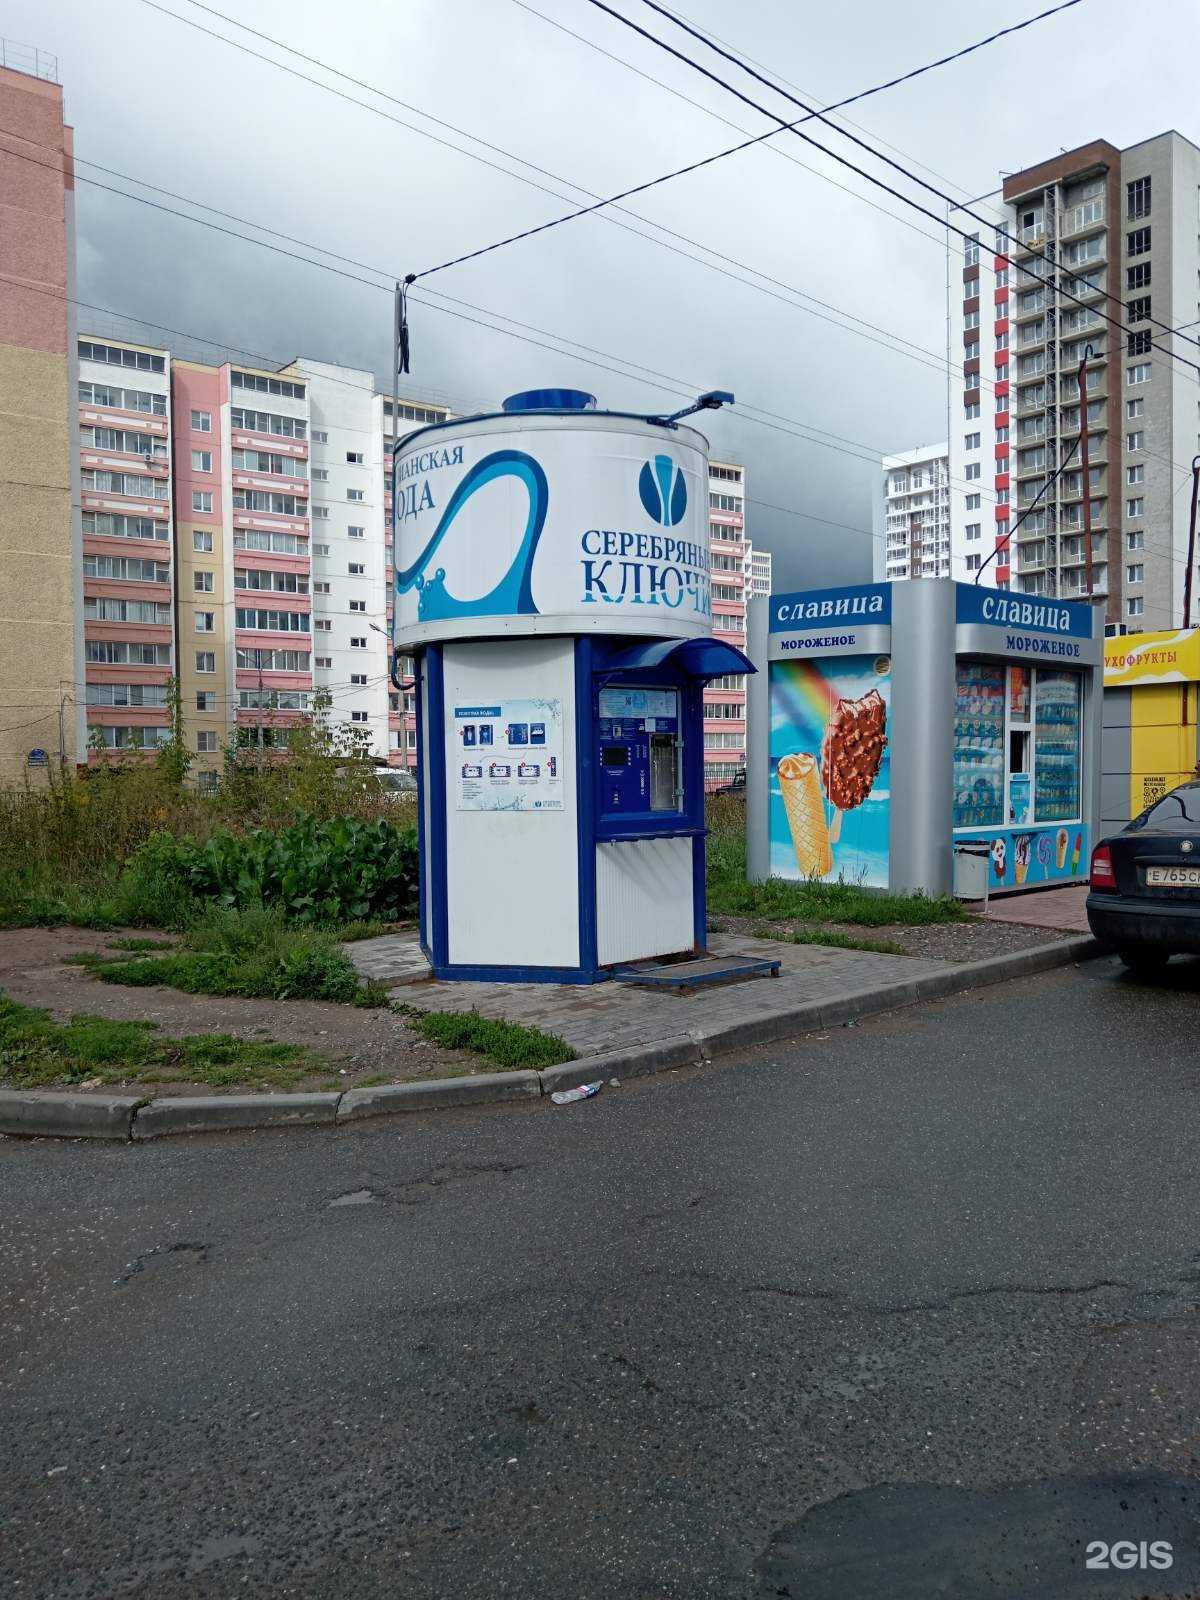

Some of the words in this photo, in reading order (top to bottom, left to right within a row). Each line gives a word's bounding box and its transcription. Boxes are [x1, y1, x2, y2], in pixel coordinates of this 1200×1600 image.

[581, 529, 710, 575] СЕРЕБРЯНЫ
[580, 559, 711, 616] КЛЮЧИ
[781, 635, 856, 650] МОРОЖЕНОЕ
[1006, 635, 1081, 657] МОРОЖЕНОЕ
[1104, 651, 1177, 668] УХОФРУКТЫ
